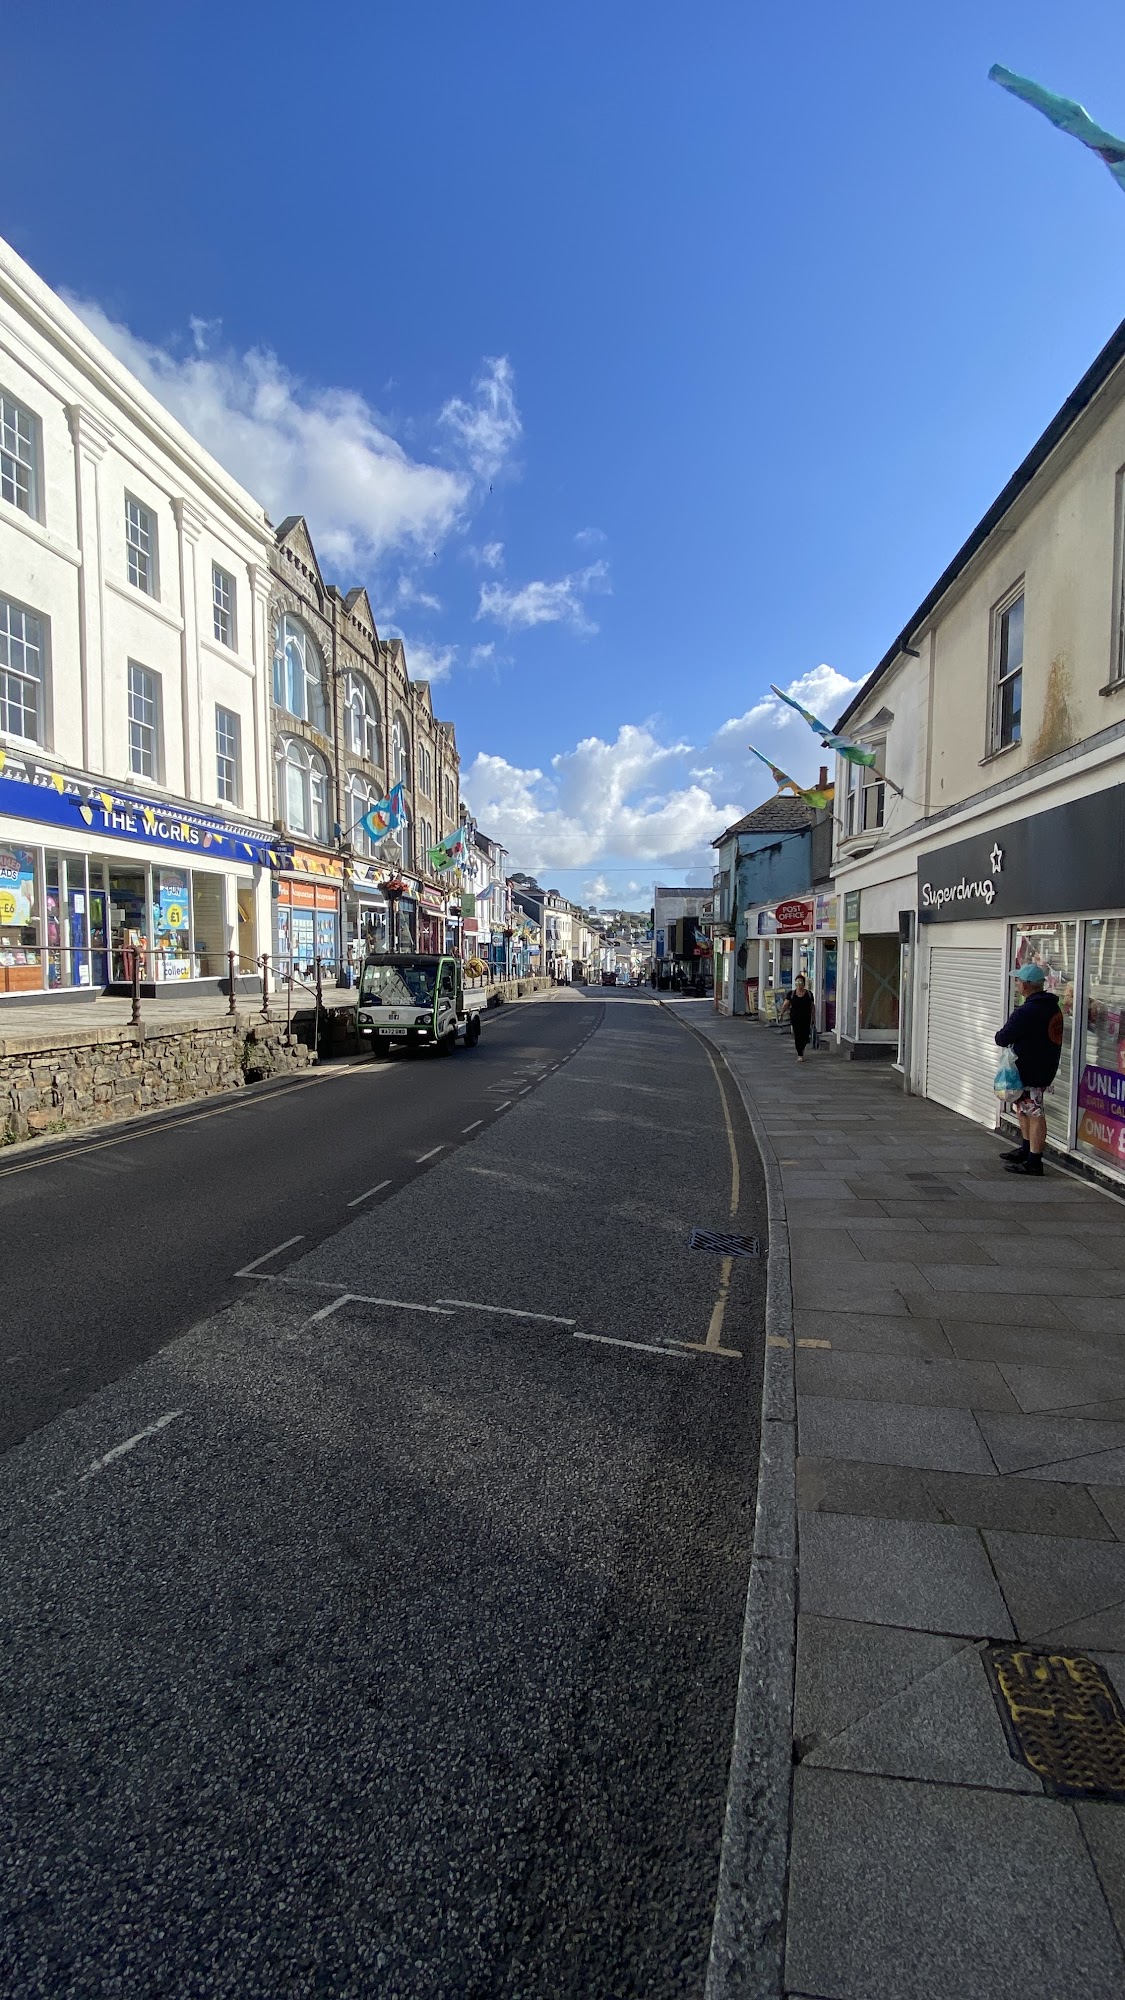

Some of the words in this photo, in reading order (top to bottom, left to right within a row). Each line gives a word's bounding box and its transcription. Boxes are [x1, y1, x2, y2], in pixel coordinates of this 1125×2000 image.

[100, 809, 138, 833] THE
[922, 876, 996, 910] Superdrug
[4, 903, 15, 913] £6
[782, 904, 801, 913] POST
[170, 912, 180, 922] £1
[778, 911, 805, 920] OFFICE
[1085, 1117, 1115, 1145] ONLY
